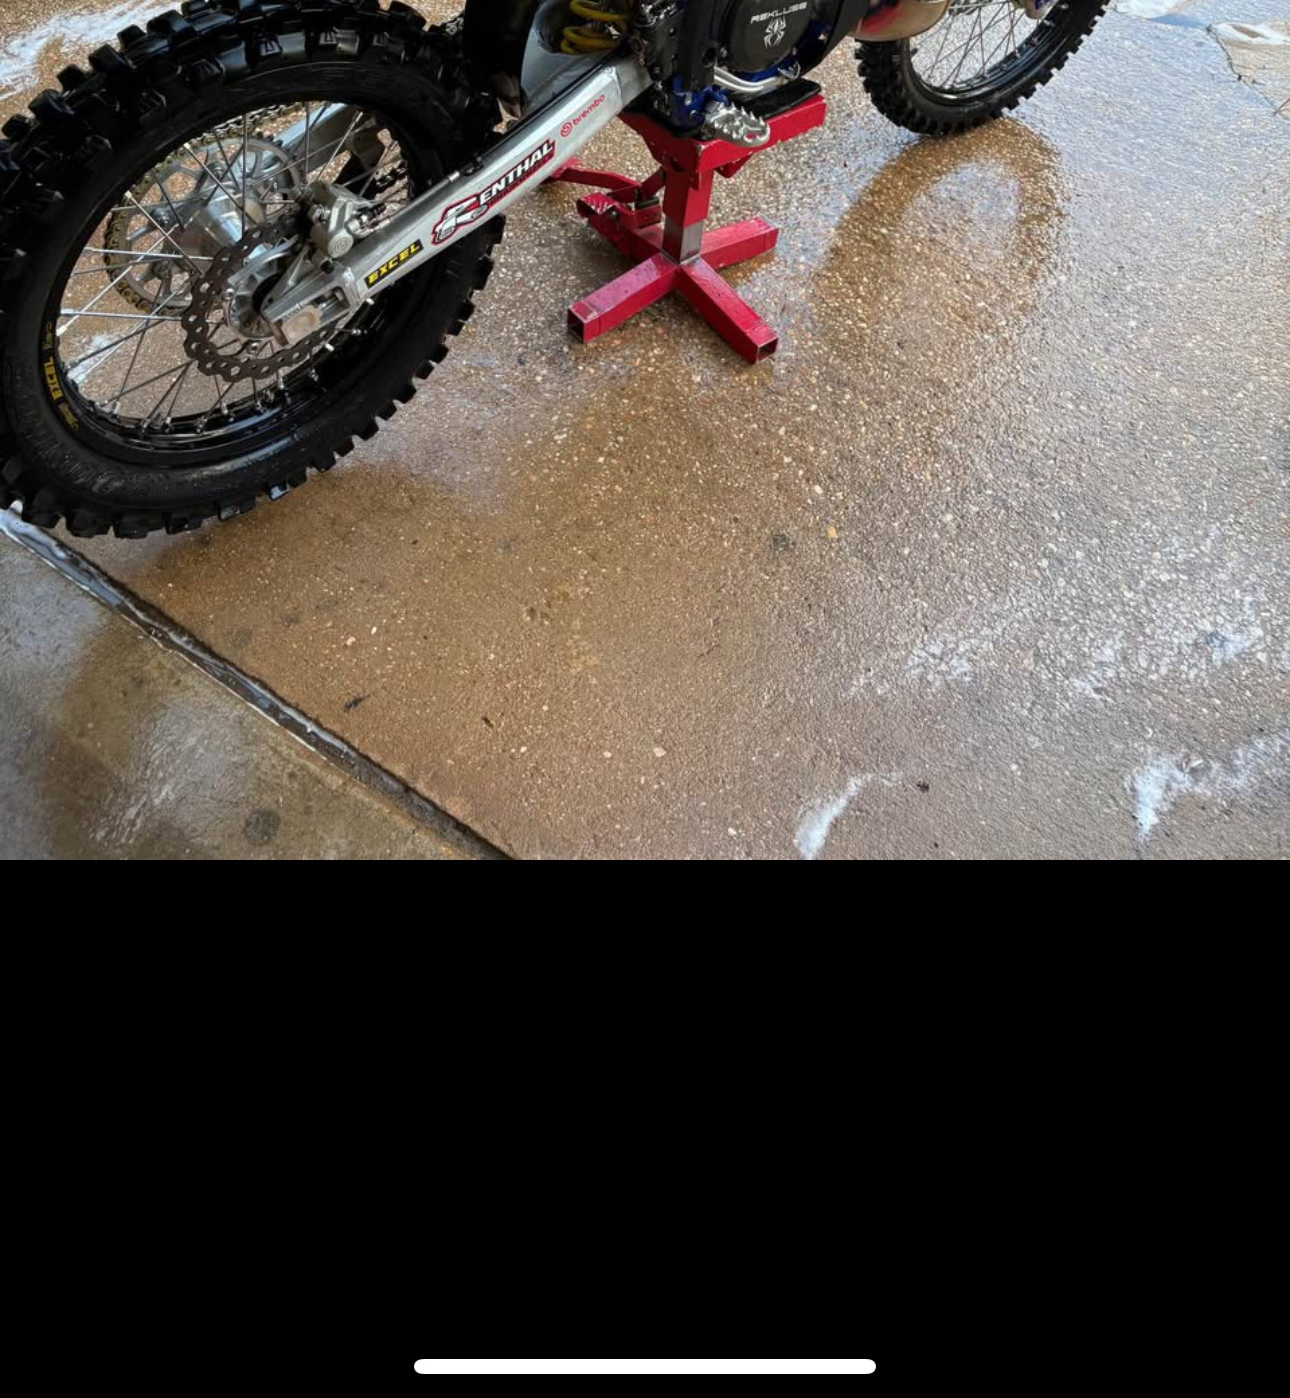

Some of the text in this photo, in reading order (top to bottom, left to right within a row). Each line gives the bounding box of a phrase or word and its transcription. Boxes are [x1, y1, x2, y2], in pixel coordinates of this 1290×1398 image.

[750, 2, 807, 24] REKLUSE
[572, 94, 606, 126] brembo
[366, 241, 422, 287] EXCEL
